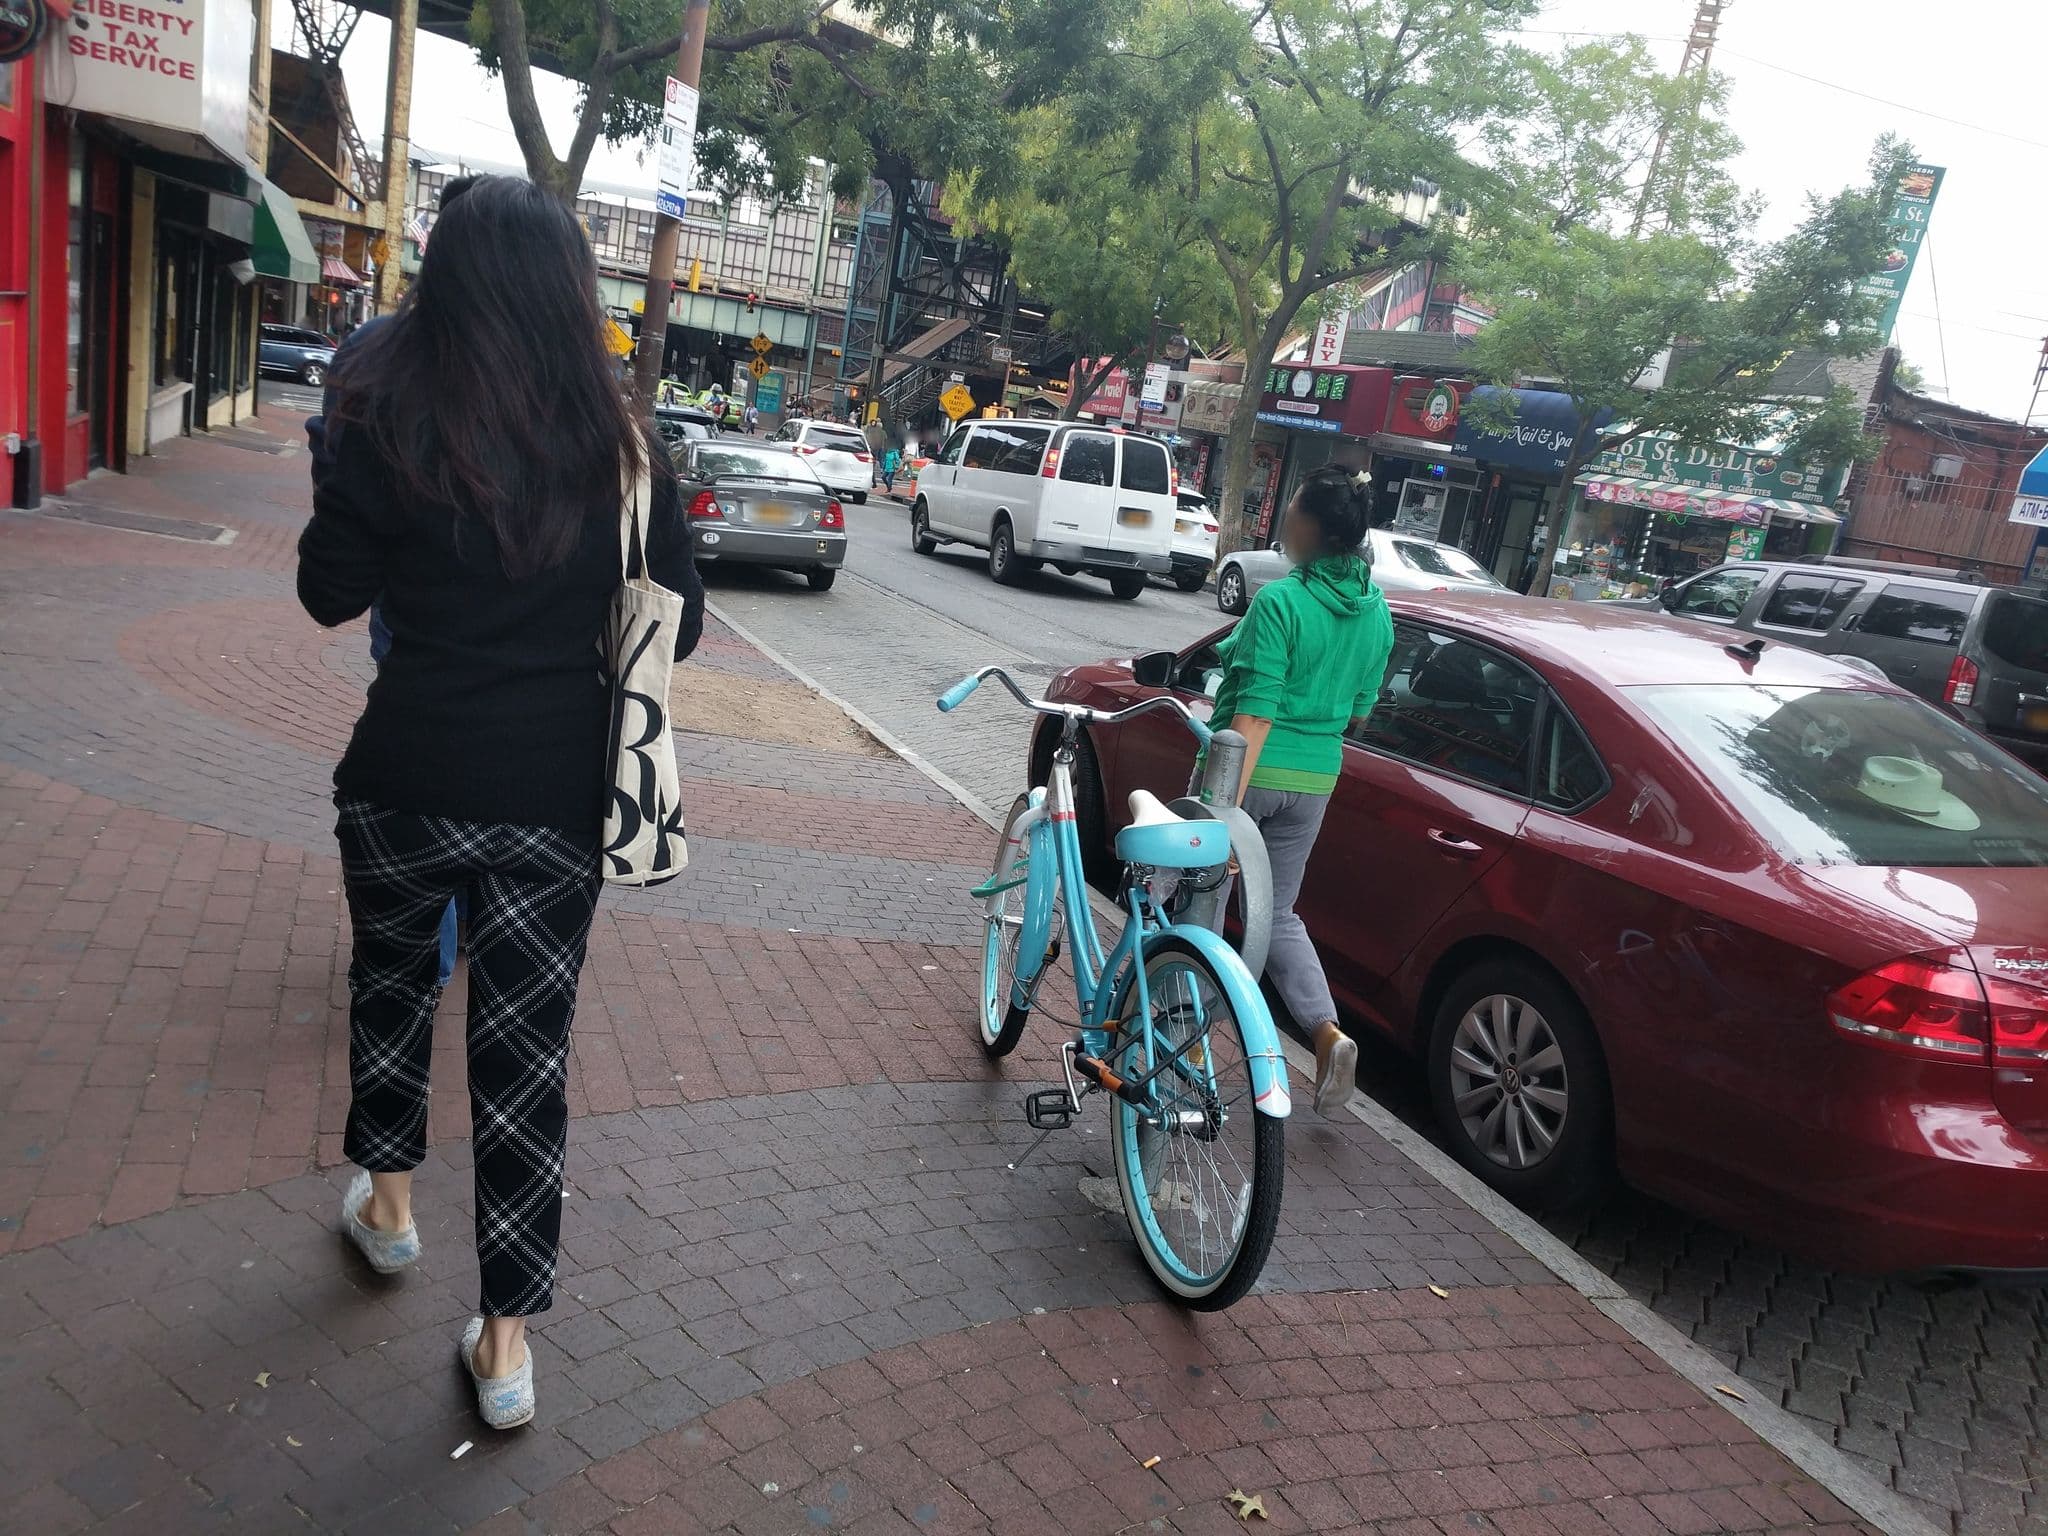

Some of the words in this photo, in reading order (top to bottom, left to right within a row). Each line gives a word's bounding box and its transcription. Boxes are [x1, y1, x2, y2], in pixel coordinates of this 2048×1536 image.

[72, 0, 194, 36] LIBERTY
[102, 22, 160, 52] TAX
[67, 35, 195, 81] SERVICE
[1508, 425, 1539, 447] Nail
[1537, 428, 1553, 444] &
[1547, 431, 1574, 452] Spa
[1620, 437, 1646, 458] 61
[1651, 441, 1680, 463] St.
[1685, 444, 1754, 472] DELI
[1589, 464, 1612, 473] COFFEE
[1615, 468, 1654, 480] SANDWICHES
[1704, 482, 1723, 490] SODA
[1727, 484, 1772, 497] CIGARETTES
